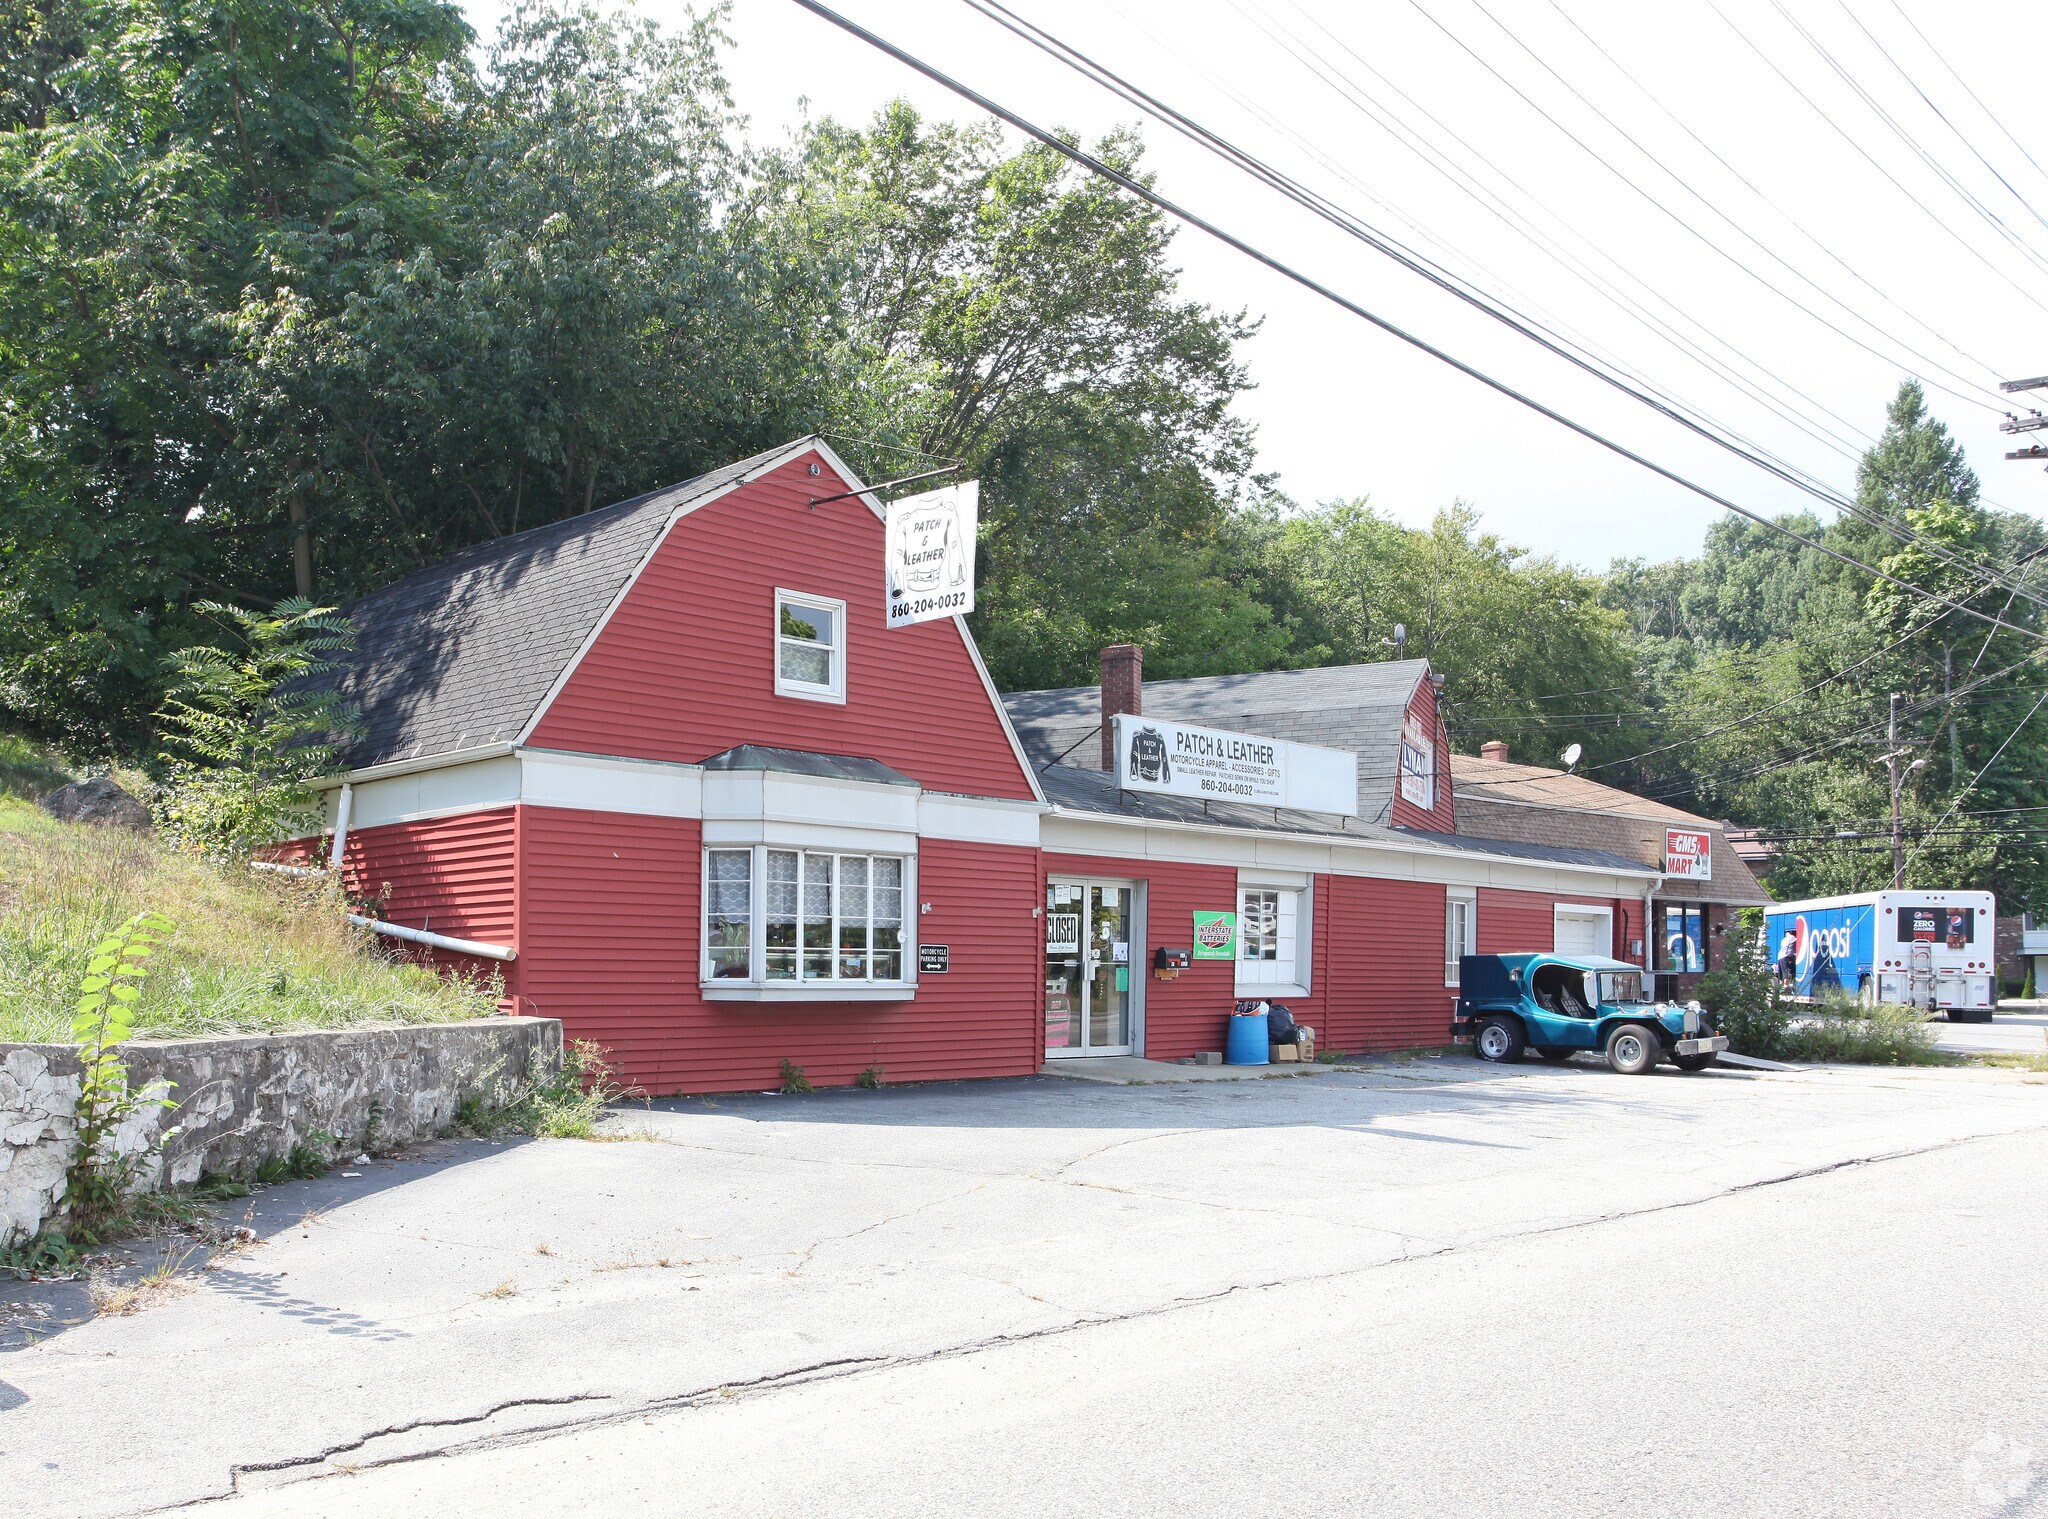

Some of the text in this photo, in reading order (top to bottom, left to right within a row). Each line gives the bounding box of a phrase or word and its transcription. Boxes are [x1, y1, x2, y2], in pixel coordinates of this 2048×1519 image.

[914, 518, 941, 533] PATCH
[921, 535, 928, 547] &
[907, 548, 944, 565] LEATHER
[891, 592, 966, 619] 860-204-0032
[1143, 739, 1157, 747] PATCH
[1177, 731, 1274, 765] PATCH & LEATHER
[1141, 753, 1159, 762] LEATHER
[1170, 753, 1205, 767] MOTORCYCLE
[1205, 759, 1228, 770] APPAREL
[1231, 763, 1264, 776] ACCESSORIES
[1267, 768, 1280, 778] GIFTS
[1176, 766, 1188, 774] SMALL
[1189, 767, 1204, 776] LEATHER
[1204, 769, 1216, 778] REPAIR
[1218, 771, 1234, 781] PATCHES
[1201, 779, 1253, 796] 860-204-0032
[1676, 835, 1697, 853] GMS
[1667, 857, 1692, 874] MART
[1047, 917, 1077, 944] CLOSED
[1198, 926, 1232, 934] INTERSTATE
[1198, 935, 1230, 943] BATTERIES
[1810, 918, 1850, 967] pepsi
